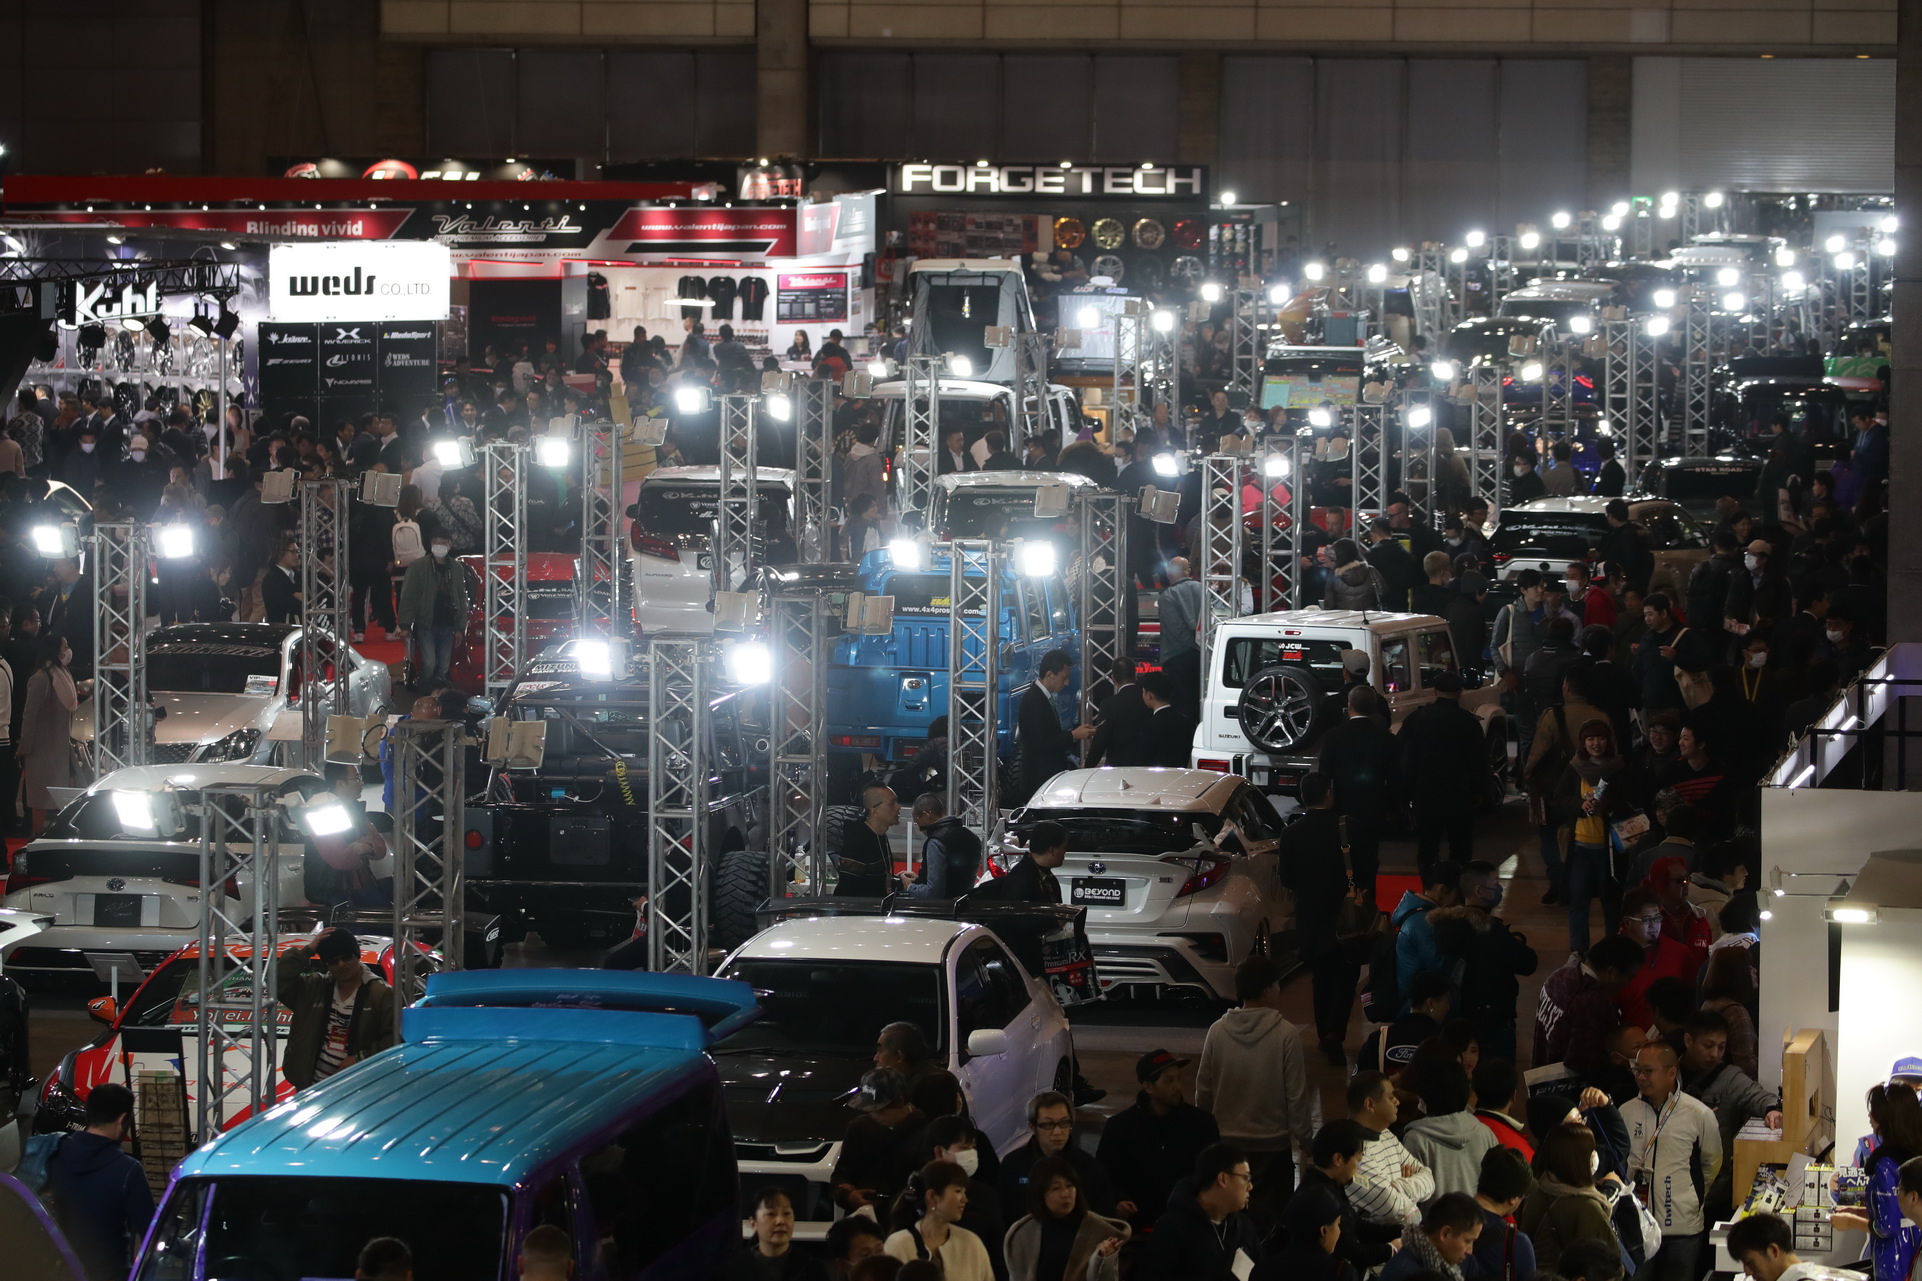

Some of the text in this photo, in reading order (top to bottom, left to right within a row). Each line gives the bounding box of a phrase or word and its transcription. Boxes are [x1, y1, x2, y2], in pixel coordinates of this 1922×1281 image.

[246, 220, 363, 237] Blinding vivid
[433, 215, 582, 234] Valenti
[641, 223, 788, 233] www.valentijapan.com
[289, 266, 376, 296] weds
[393, 359, 430, 367] ADVENTURE
[1084, 888, 1121, 897] BEYOND
